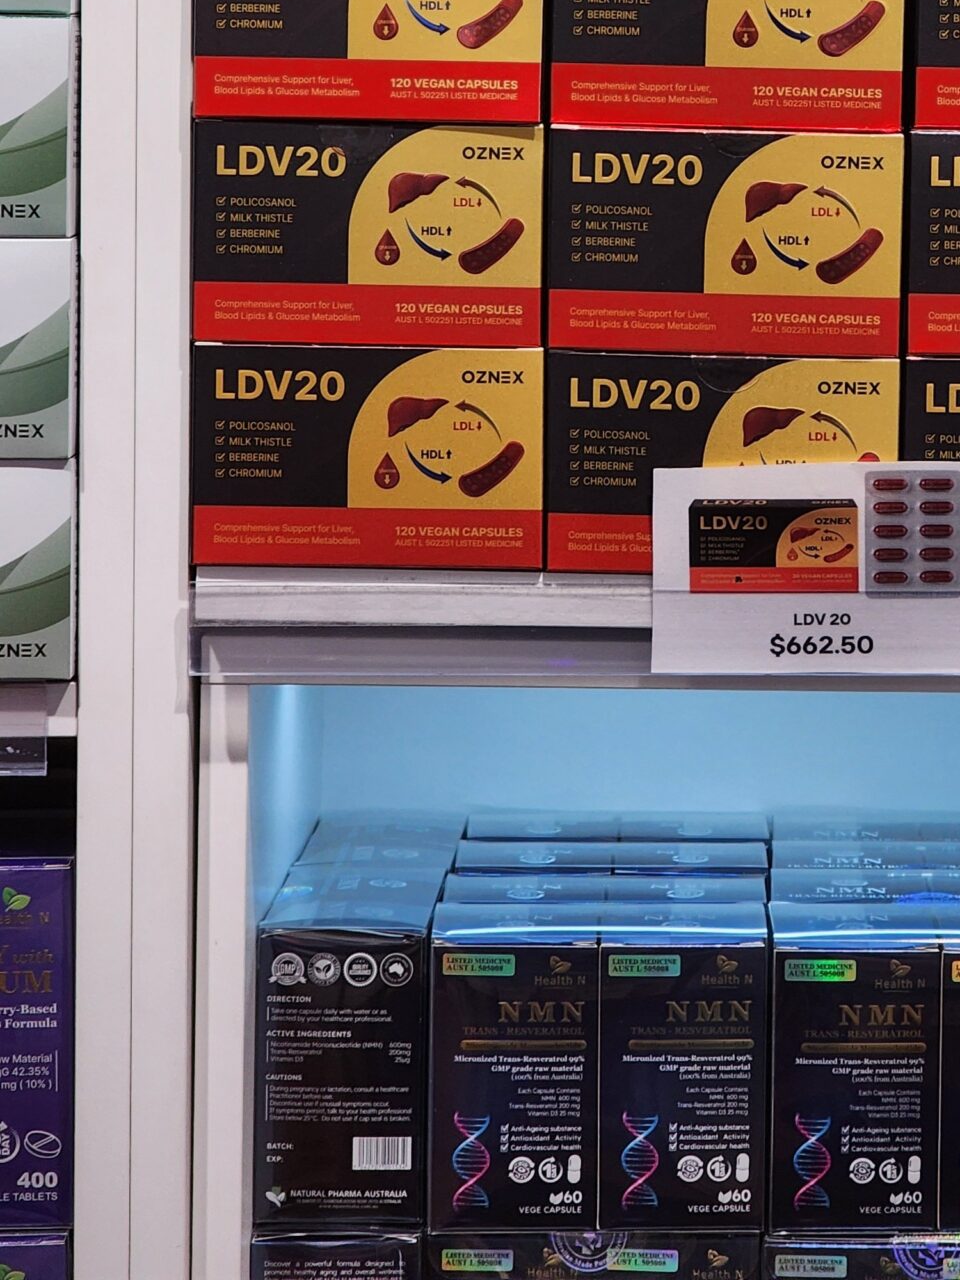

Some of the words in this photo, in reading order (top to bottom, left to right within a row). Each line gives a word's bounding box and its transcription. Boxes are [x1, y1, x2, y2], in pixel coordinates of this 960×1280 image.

[572, 152, 703, 186] LDV20
[216, 369, 345, 401] LDV20
[700, 516, 767, 530] LDV20
[815, 518, 852, 526] OZNEX
[794, 613, 826, 626] LDV
[830, 614, 851, 626] 20
[770, 634, 874, 657] $662.50
[266, 995, 312, 1003] DIRECTION
[498, 1001, 585, 1023] NMN
[5, 1017, 58, 1030] Formula
[266, 1030, 295, 1038] ACTIVE
[296, 1030, 352, 1039] INGREDIENTS
[12, 1054, 53, 1064] Material
[12, 1066, 51, 1077] 42.35%
[265, 1073, 303, 1081] CAUTIONS
[510, 1125, 550, 1134] Anti-Ageing
[510, 1134, 550, 1142] Antioxidant
[555, 1134, 582, 1143] Activity
[510, 1143, 559, 1151] Cardiovascular
[560, 1143, 582, 1151] health
[17, 1172, 58, 1188] 400
[13, 1191, 58, 1202] TABLETS
[364, 1190, 407, 1198] AUSTRALIA
[563, 1190, 583, 1204] 60
[518, 1206, 543, 1215] VEGE
[543, 1205, 583, 1214] CAPSULE
